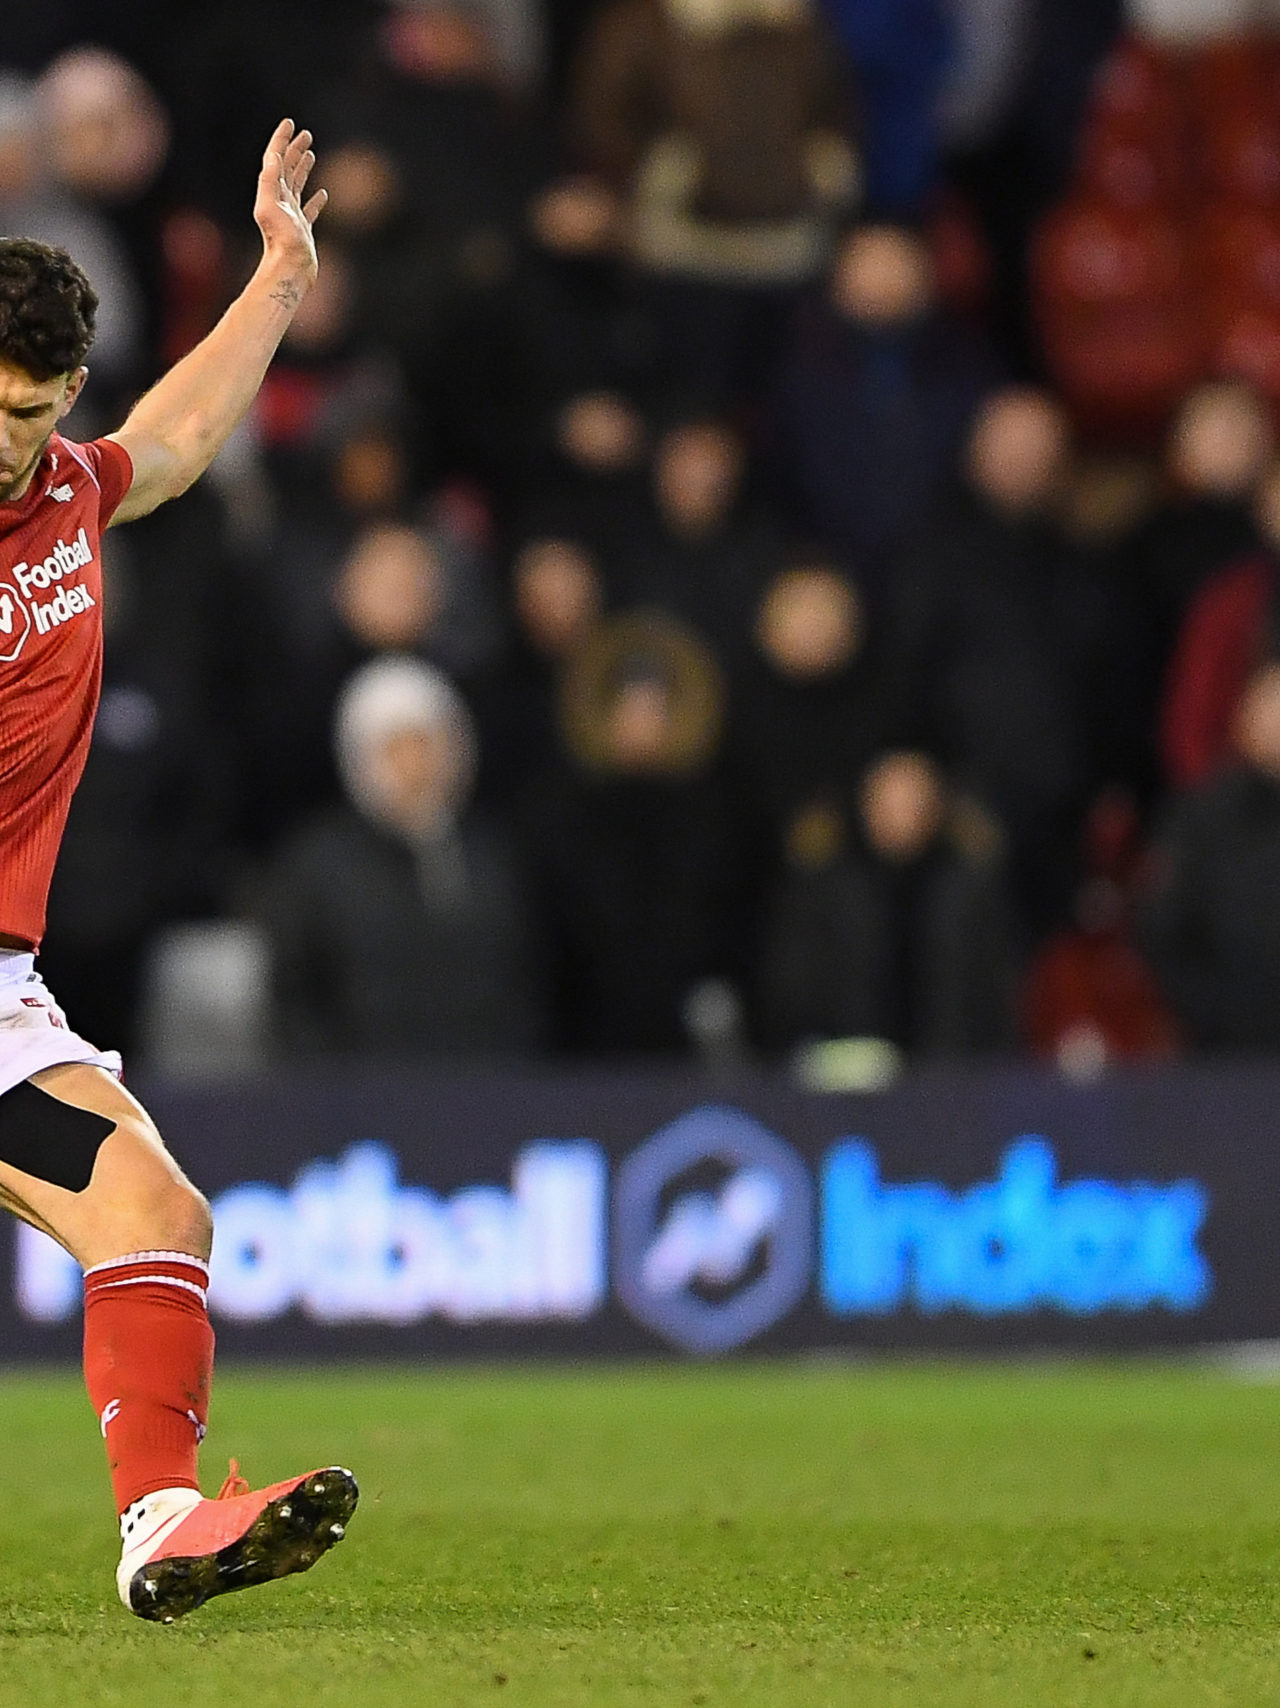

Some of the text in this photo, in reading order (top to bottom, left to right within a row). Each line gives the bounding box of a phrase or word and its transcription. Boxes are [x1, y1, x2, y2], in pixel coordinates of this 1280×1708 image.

[12, 527, 93, 599] Football
[30, 583, 96, 635] Index
[15, 1134, 1214, 1323] otball Index
